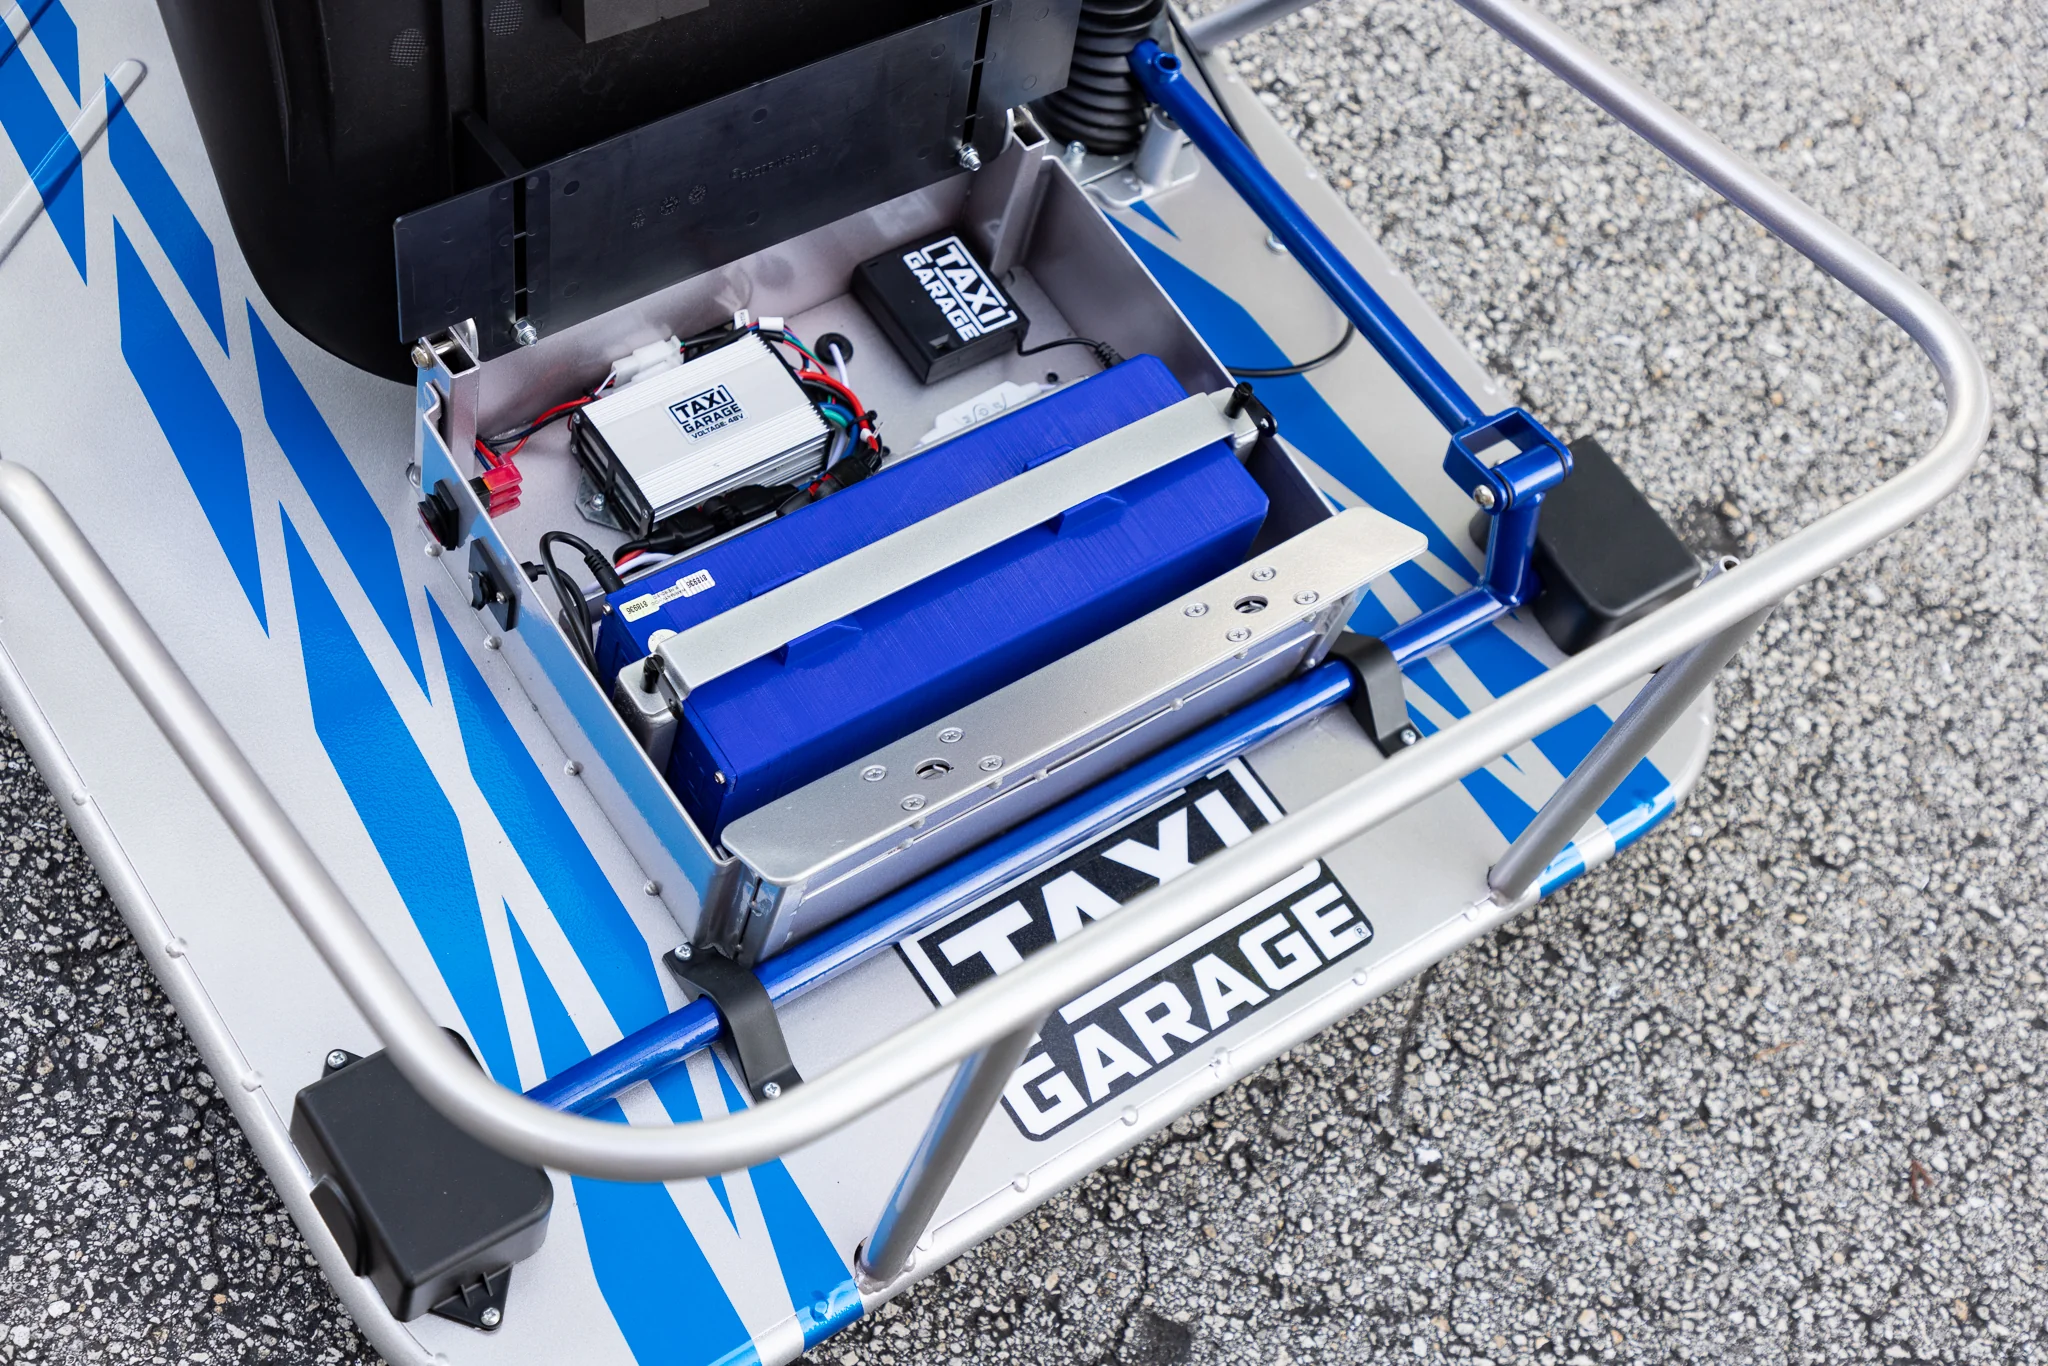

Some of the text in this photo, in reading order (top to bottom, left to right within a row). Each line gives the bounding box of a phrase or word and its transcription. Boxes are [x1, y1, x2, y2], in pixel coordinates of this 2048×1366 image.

[903, 251, 981, 341] GARAGE
[935, 244, 1006, 324] TAXI
[675, 389, 727, 418] TAXI
[683, 403, 741, 433] GARAGE
[691, 413, 744, 438] VOLTAGE: 48V
[1002, 882, 1372, 1136] GARAGE
